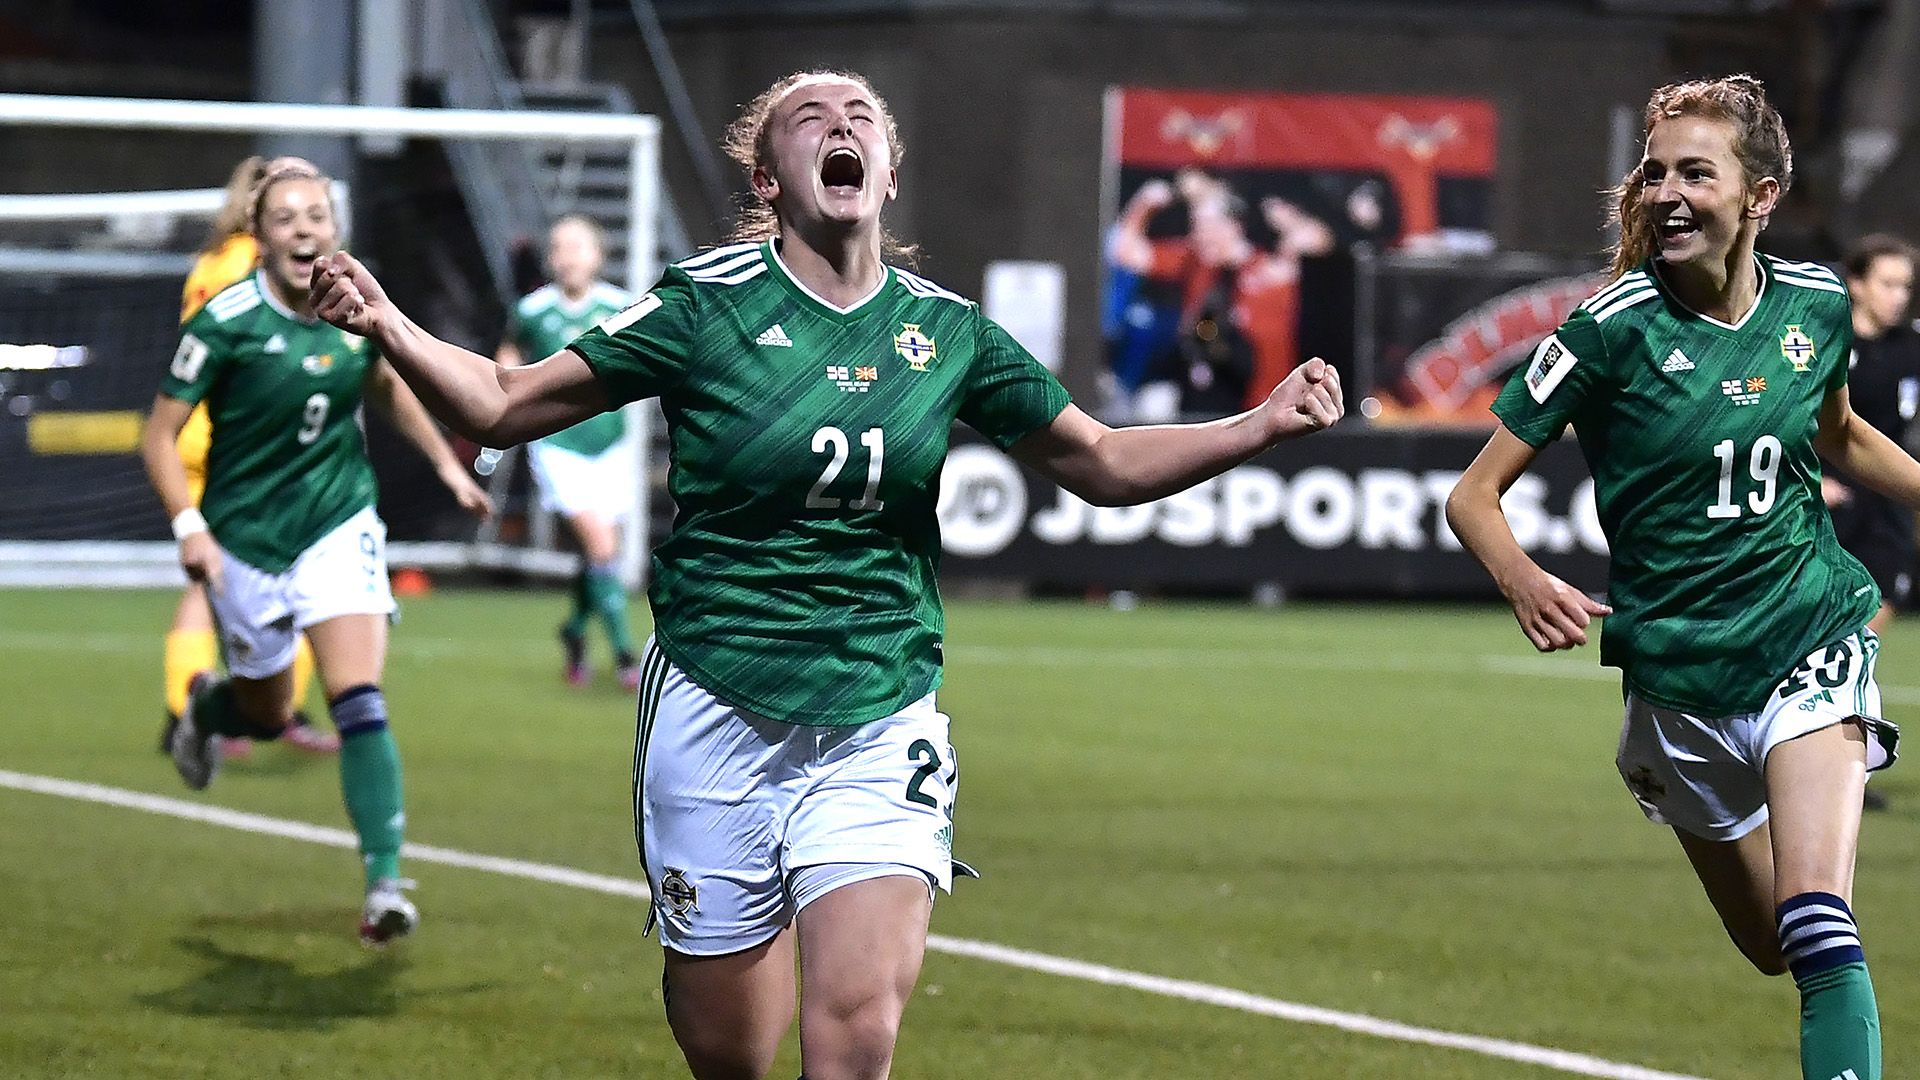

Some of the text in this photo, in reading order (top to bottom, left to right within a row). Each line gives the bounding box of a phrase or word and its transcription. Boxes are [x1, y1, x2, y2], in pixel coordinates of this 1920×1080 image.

[298, 393, 331, 445] 9
[806, 426, 884, 511] 21
[1706, 434, 1782, 518] 19
